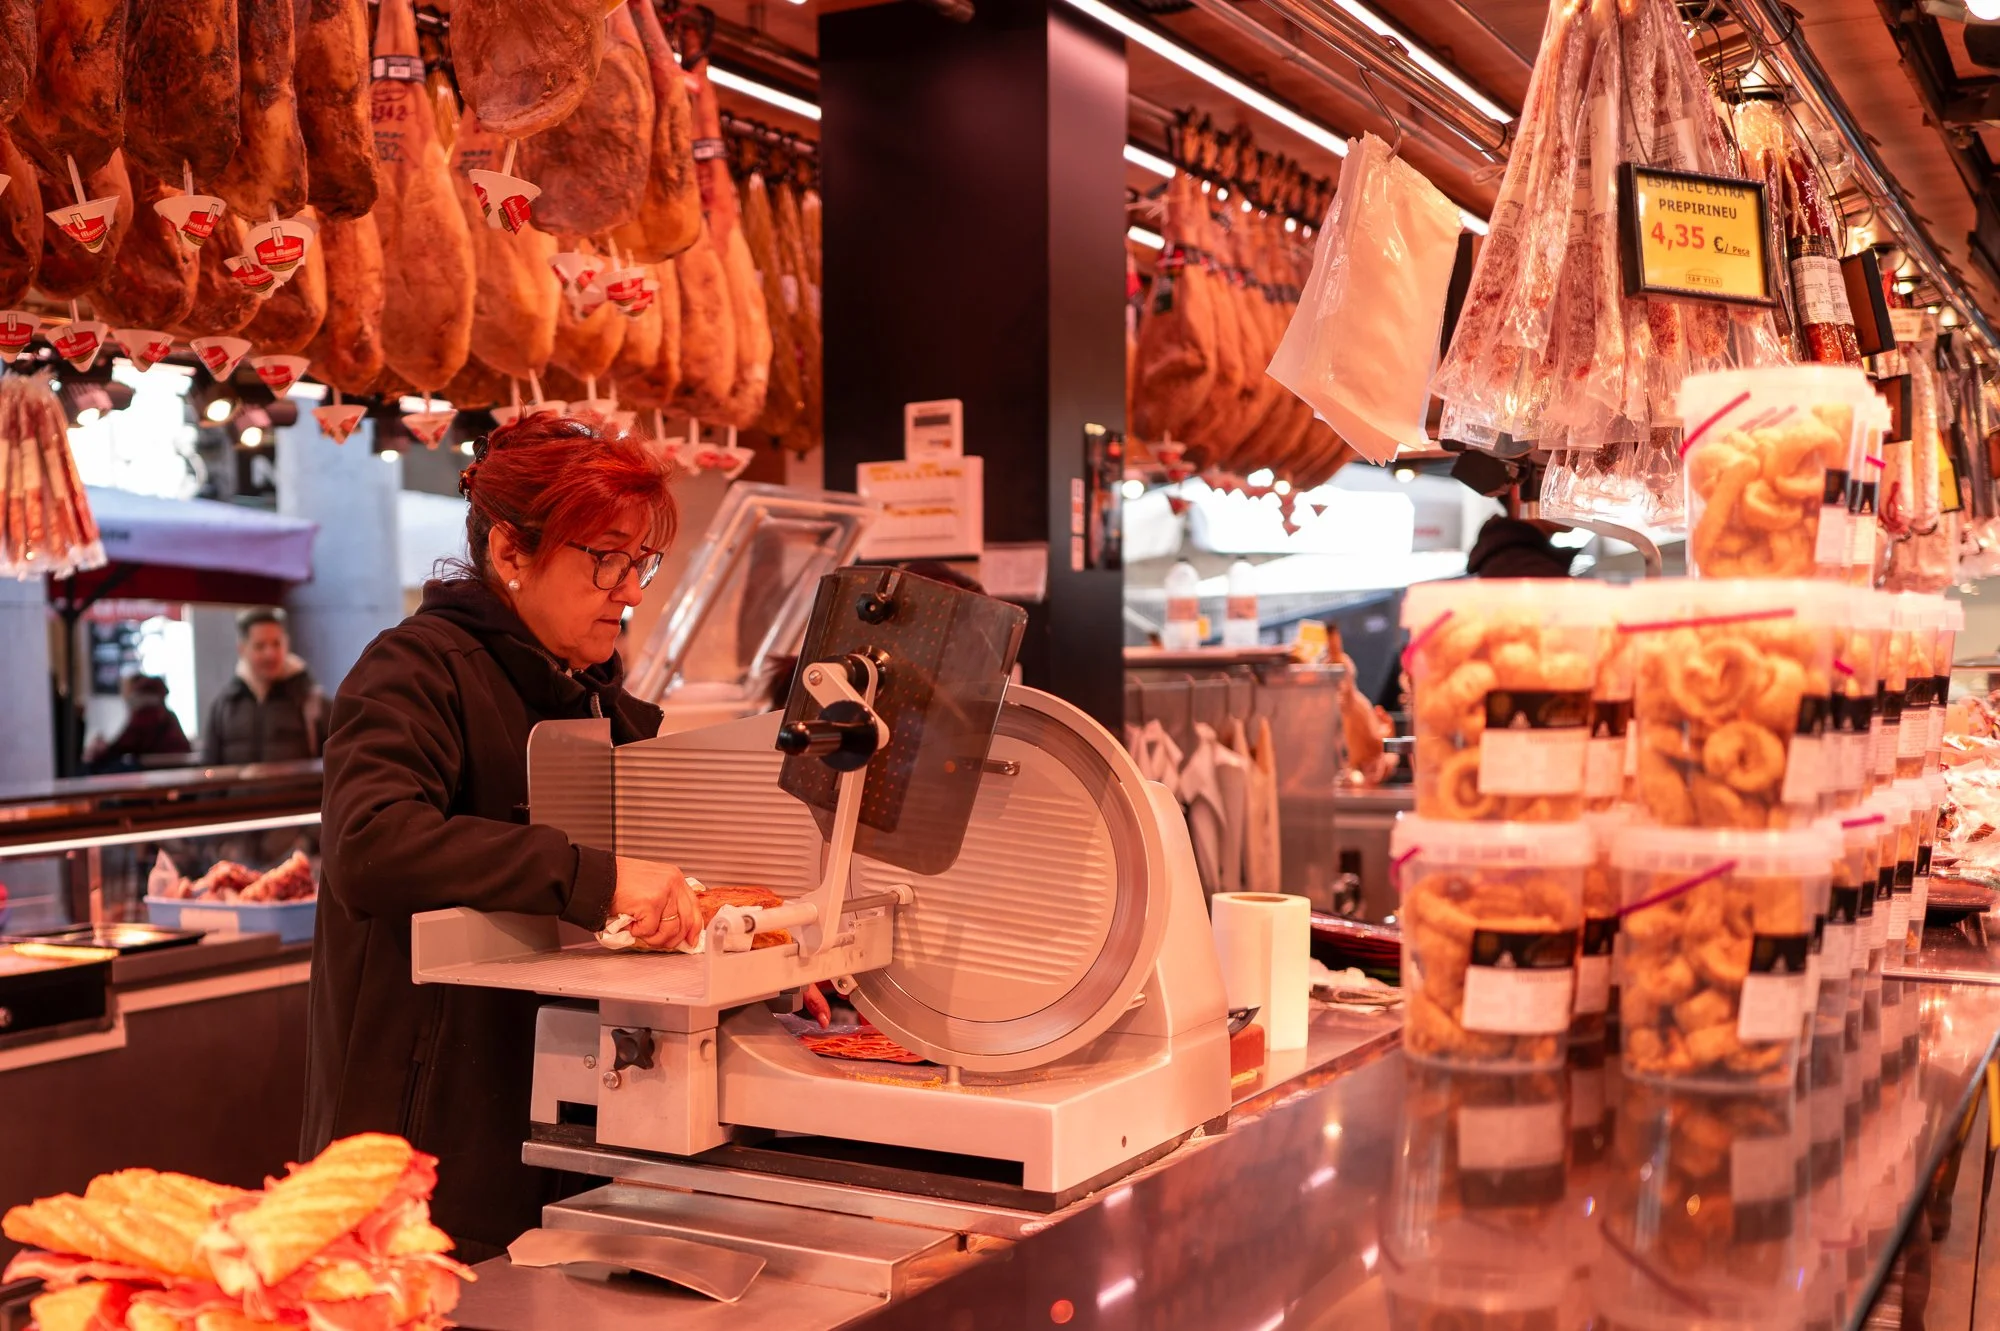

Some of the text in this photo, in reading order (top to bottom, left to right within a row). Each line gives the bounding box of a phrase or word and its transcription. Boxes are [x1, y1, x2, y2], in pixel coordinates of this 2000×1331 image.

[1646, 176, 1746, 200] ESPATEC EXTRA
[1659, 198, 1737, 219] PREPIRINEU
[1651, 221, 1705, 251] 4,35
